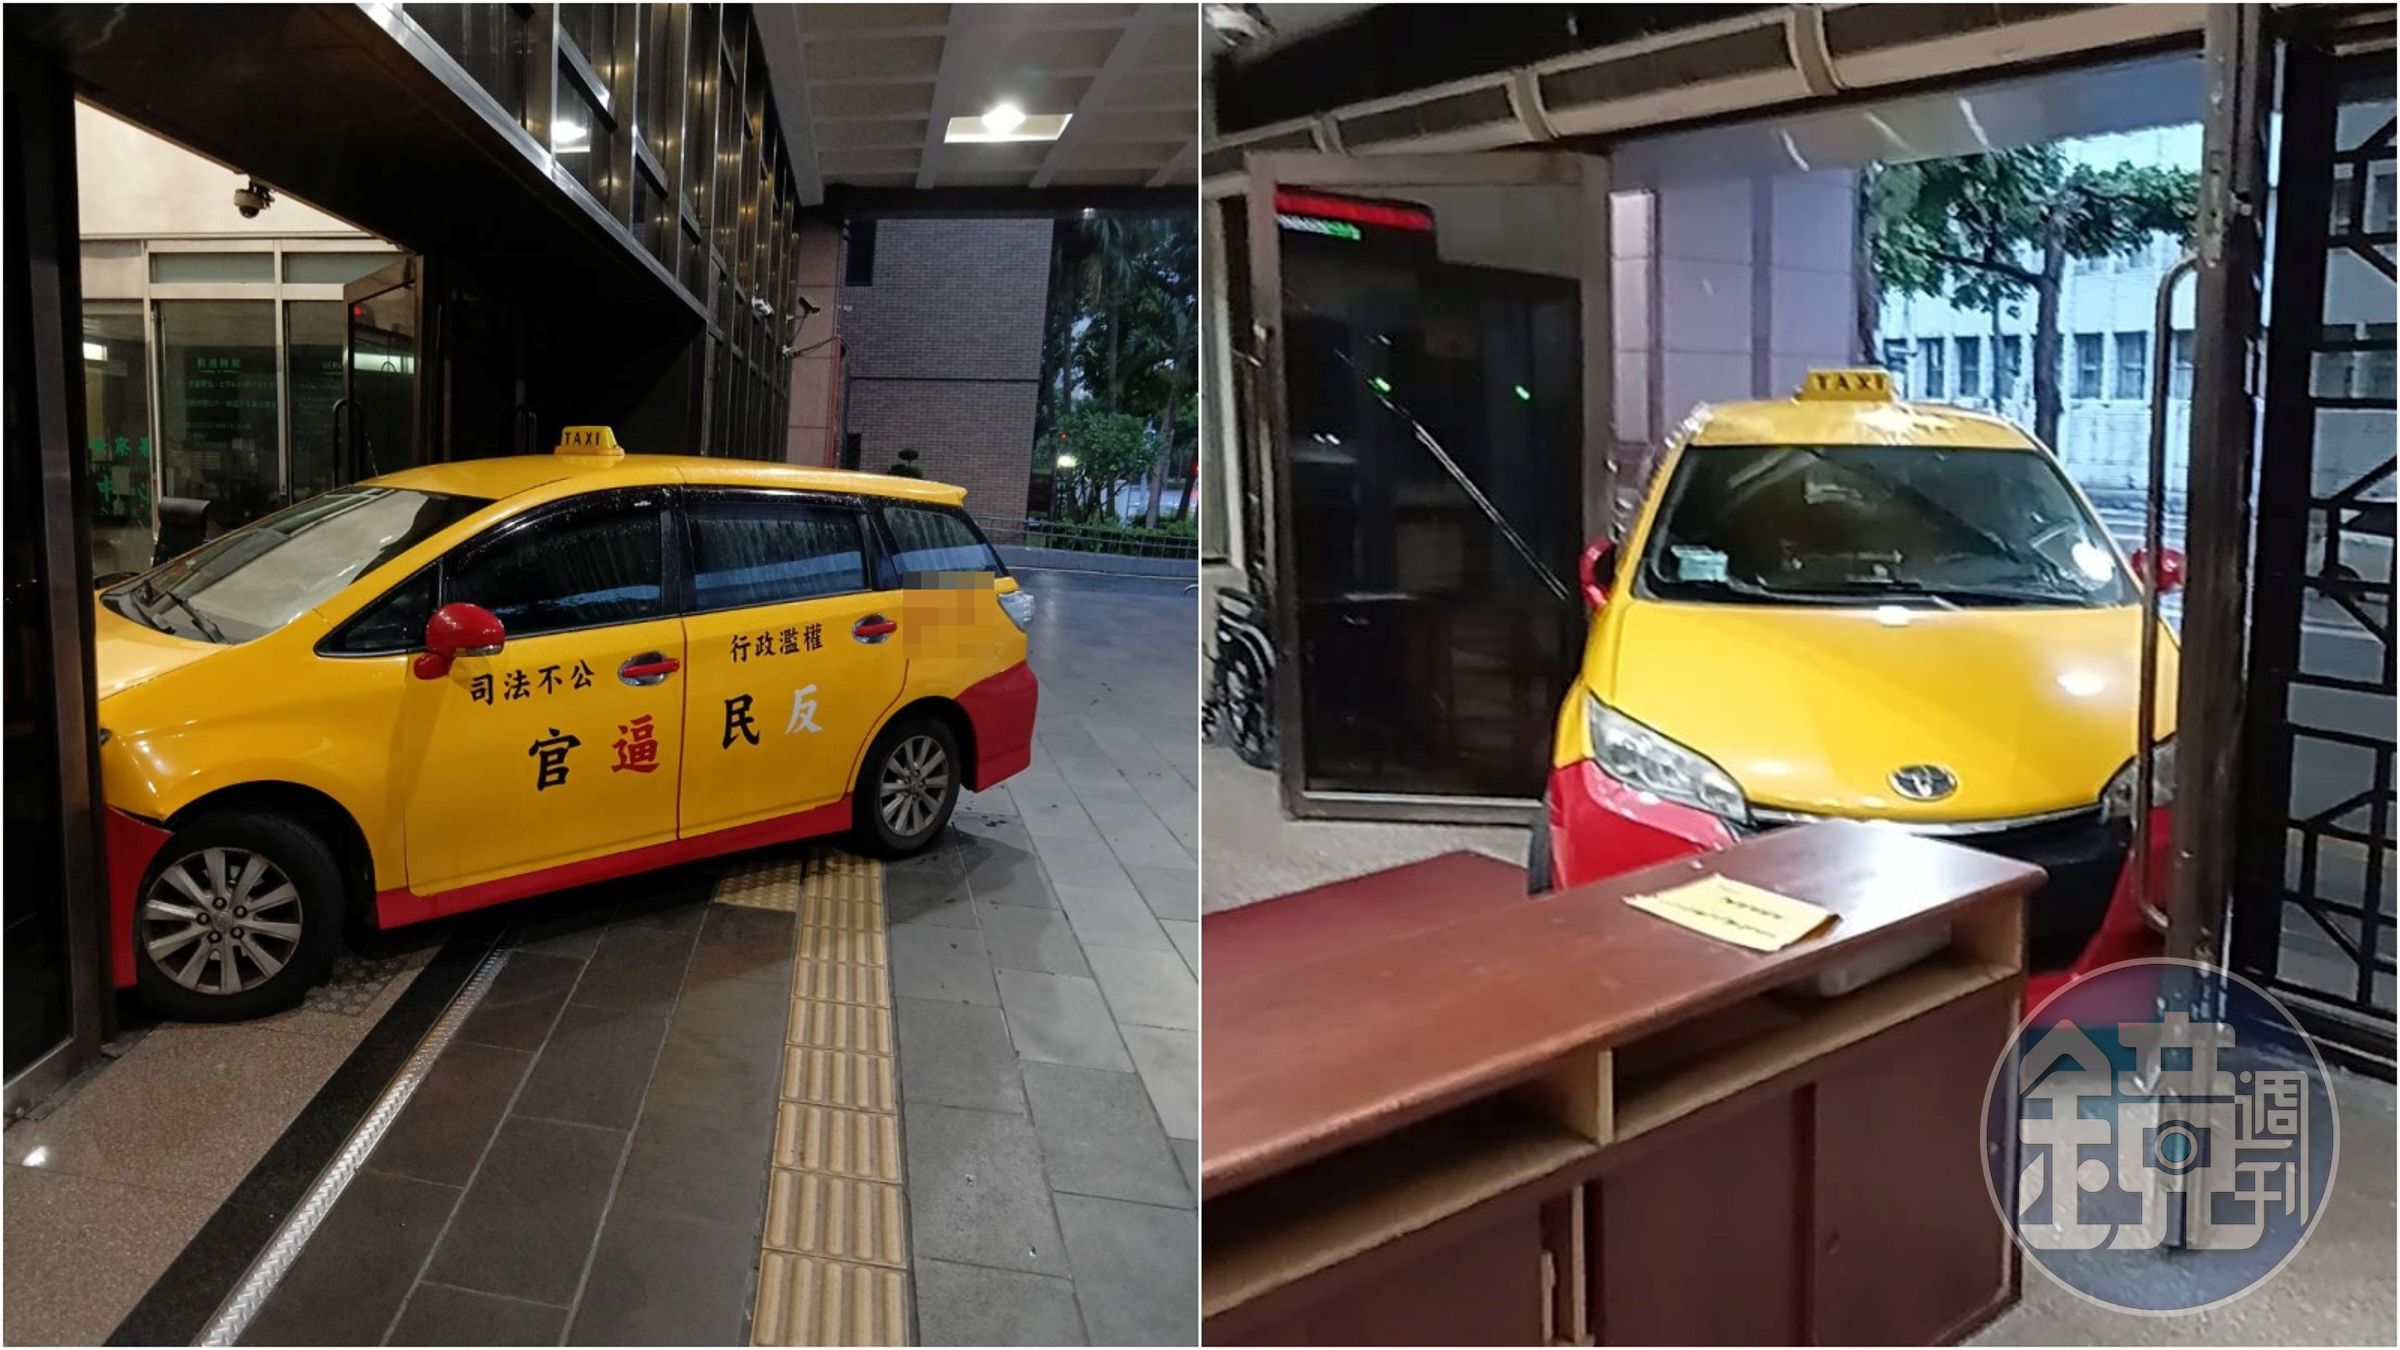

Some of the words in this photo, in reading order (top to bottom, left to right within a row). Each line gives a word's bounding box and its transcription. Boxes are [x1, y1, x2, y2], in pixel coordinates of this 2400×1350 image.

[1816, 373, 1885, 391] TAXI
[564, 431, 600, 446] TAXI
[730, 623, 823, 663] 行政濫權
[470, 659, 596, 706] 司法不公
[528, 683, 823, 792] 官逼民反
